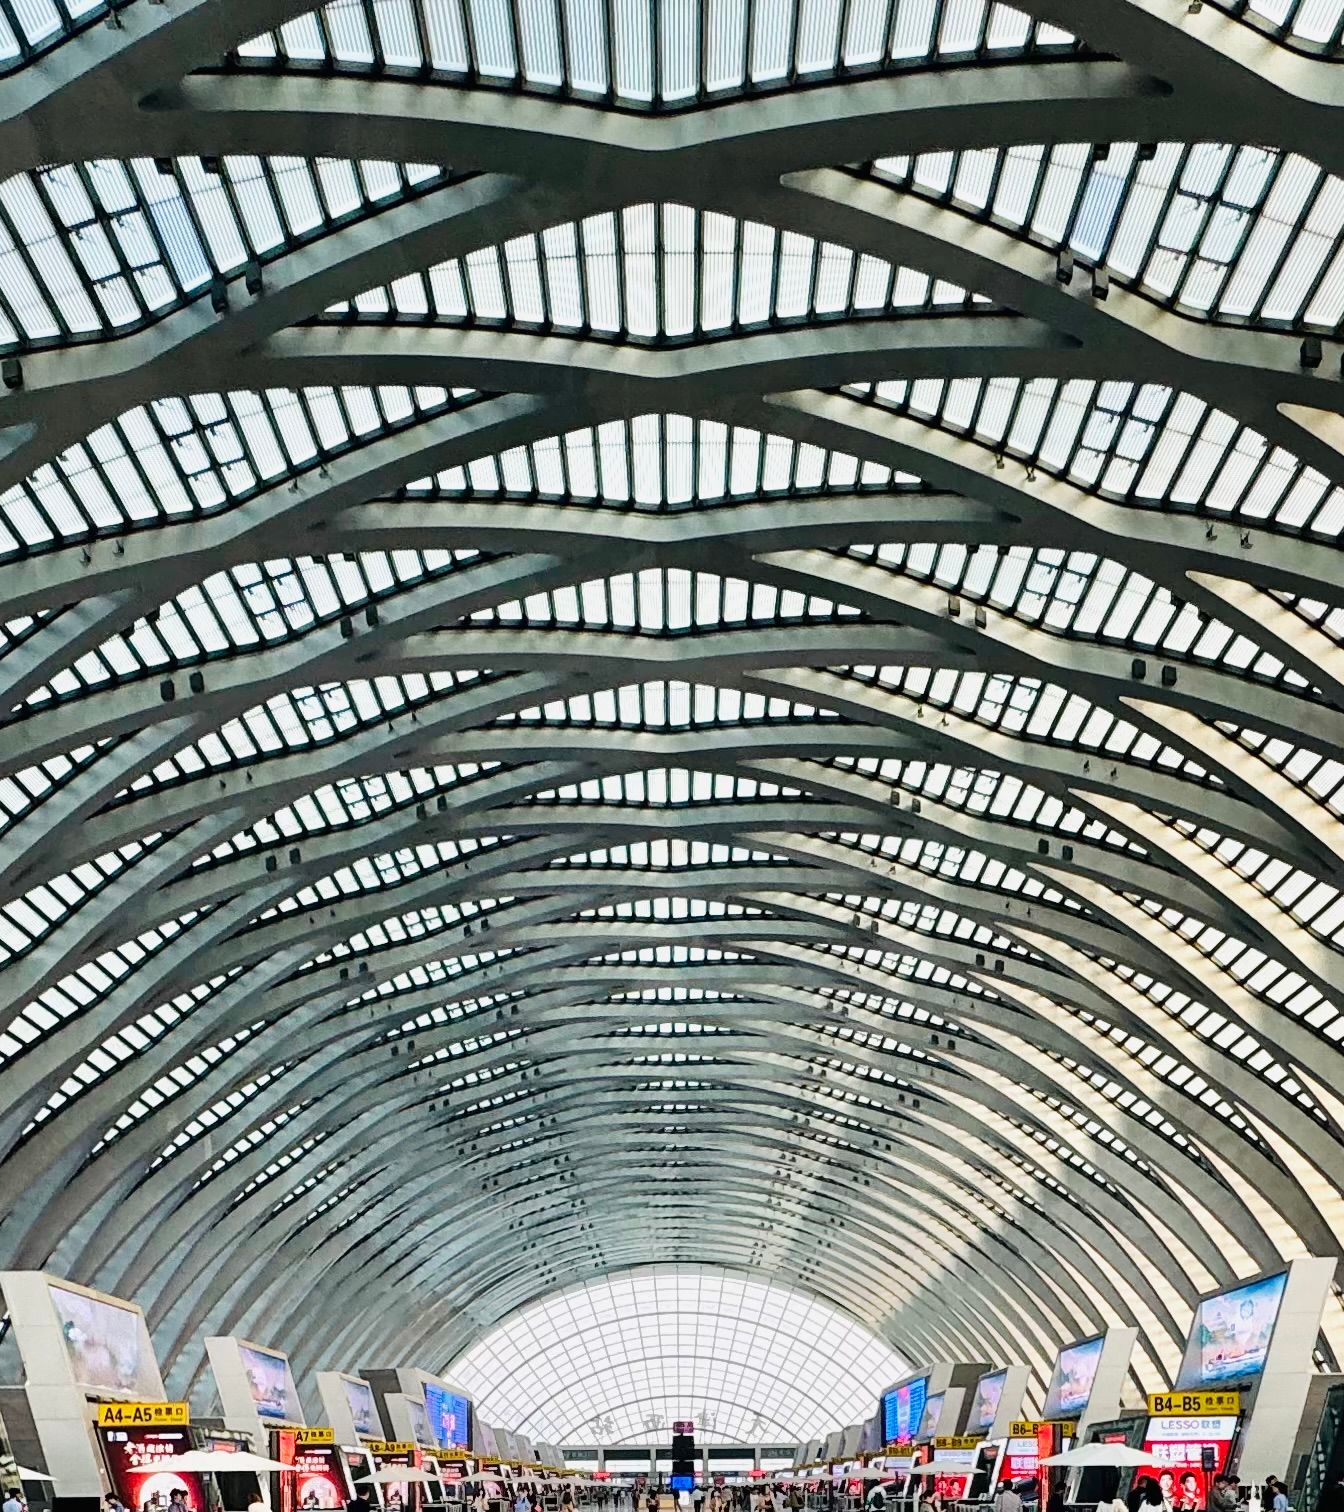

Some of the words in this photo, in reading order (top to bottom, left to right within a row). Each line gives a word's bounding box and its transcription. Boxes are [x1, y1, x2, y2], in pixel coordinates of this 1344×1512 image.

[1154, 1396, 1201, 1412] B4-B5
[103, 1407, 153, 1423] A4-A5
[1012, 1423, 1039, 1435] B6-B
[1160, 1420, 1200, 1430] LESSO
[1151, 1444, 1219, 1462] 联塑管
